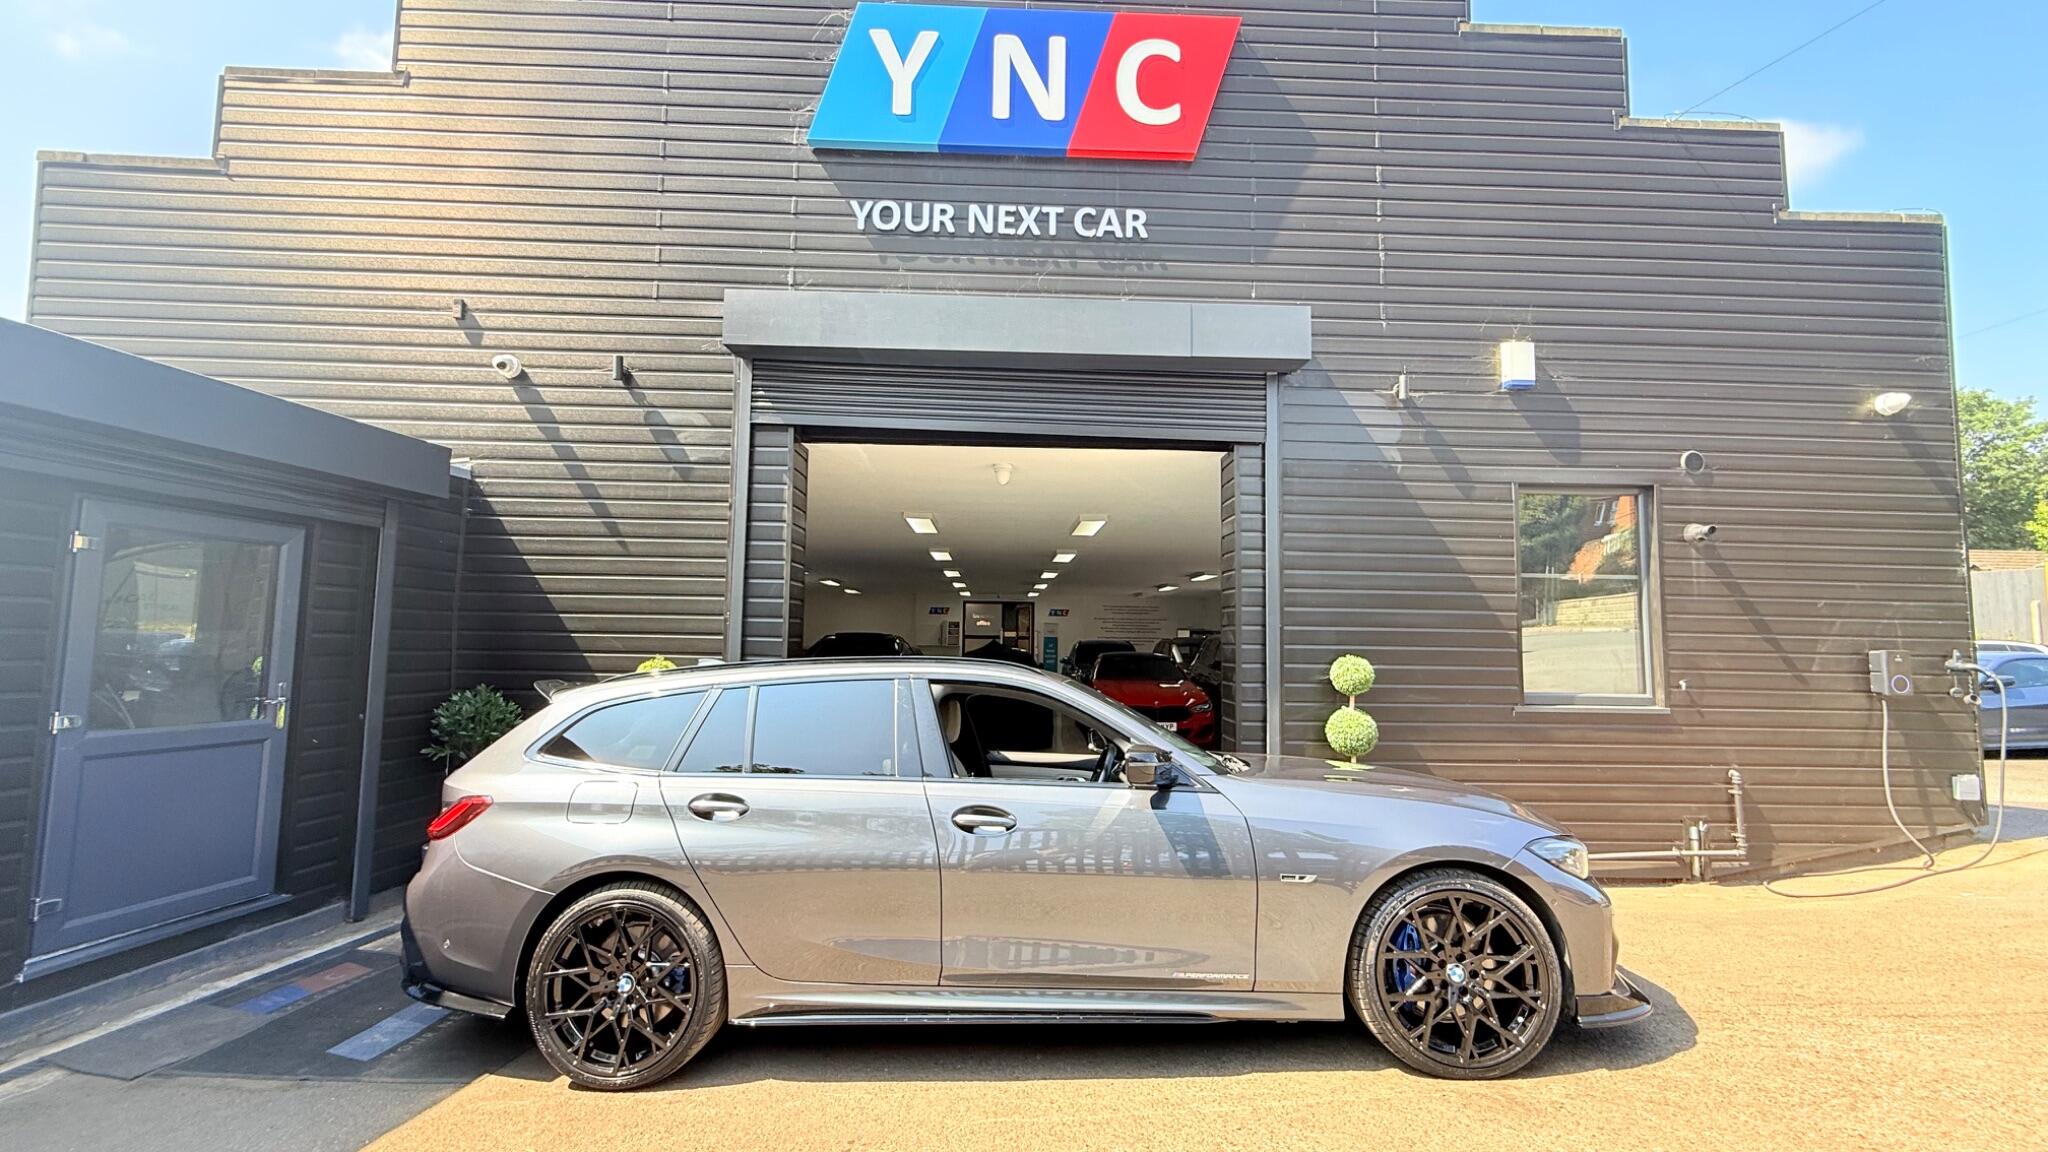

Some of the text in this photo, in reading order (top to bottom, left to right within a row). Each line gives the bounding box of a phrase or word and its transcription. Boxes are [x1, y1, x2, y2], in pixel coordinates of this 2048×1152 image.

[868, 28, 1182, 126] YNC
[850, 200, 1149, 239] YOUR NEXT CAR
